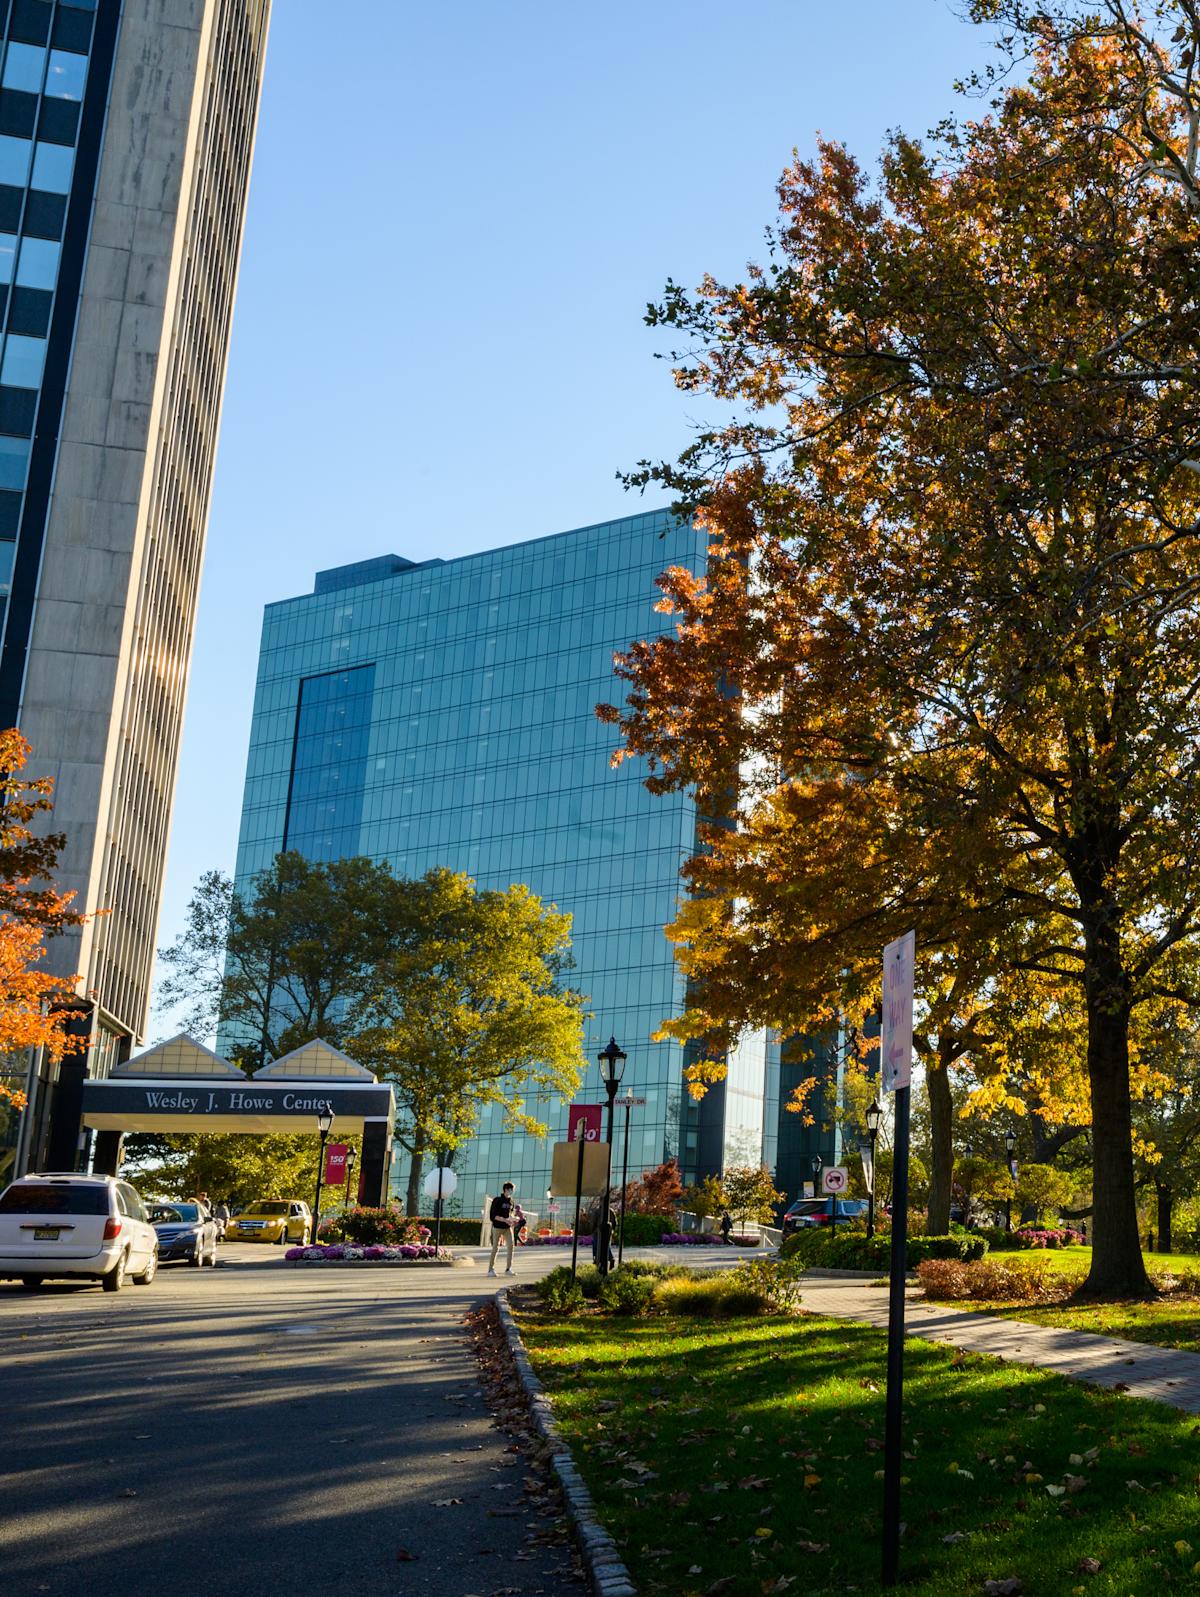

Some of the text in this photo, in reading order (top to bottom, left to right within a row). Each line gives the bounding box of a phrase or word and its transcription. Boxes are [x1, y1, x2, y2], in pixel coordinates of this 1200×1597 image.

[890, 959, 905, 989] ONE
[888, 997, 906, 1028] WAY
[145, 1092, 332, 1112] Wesley J. Howe Center
